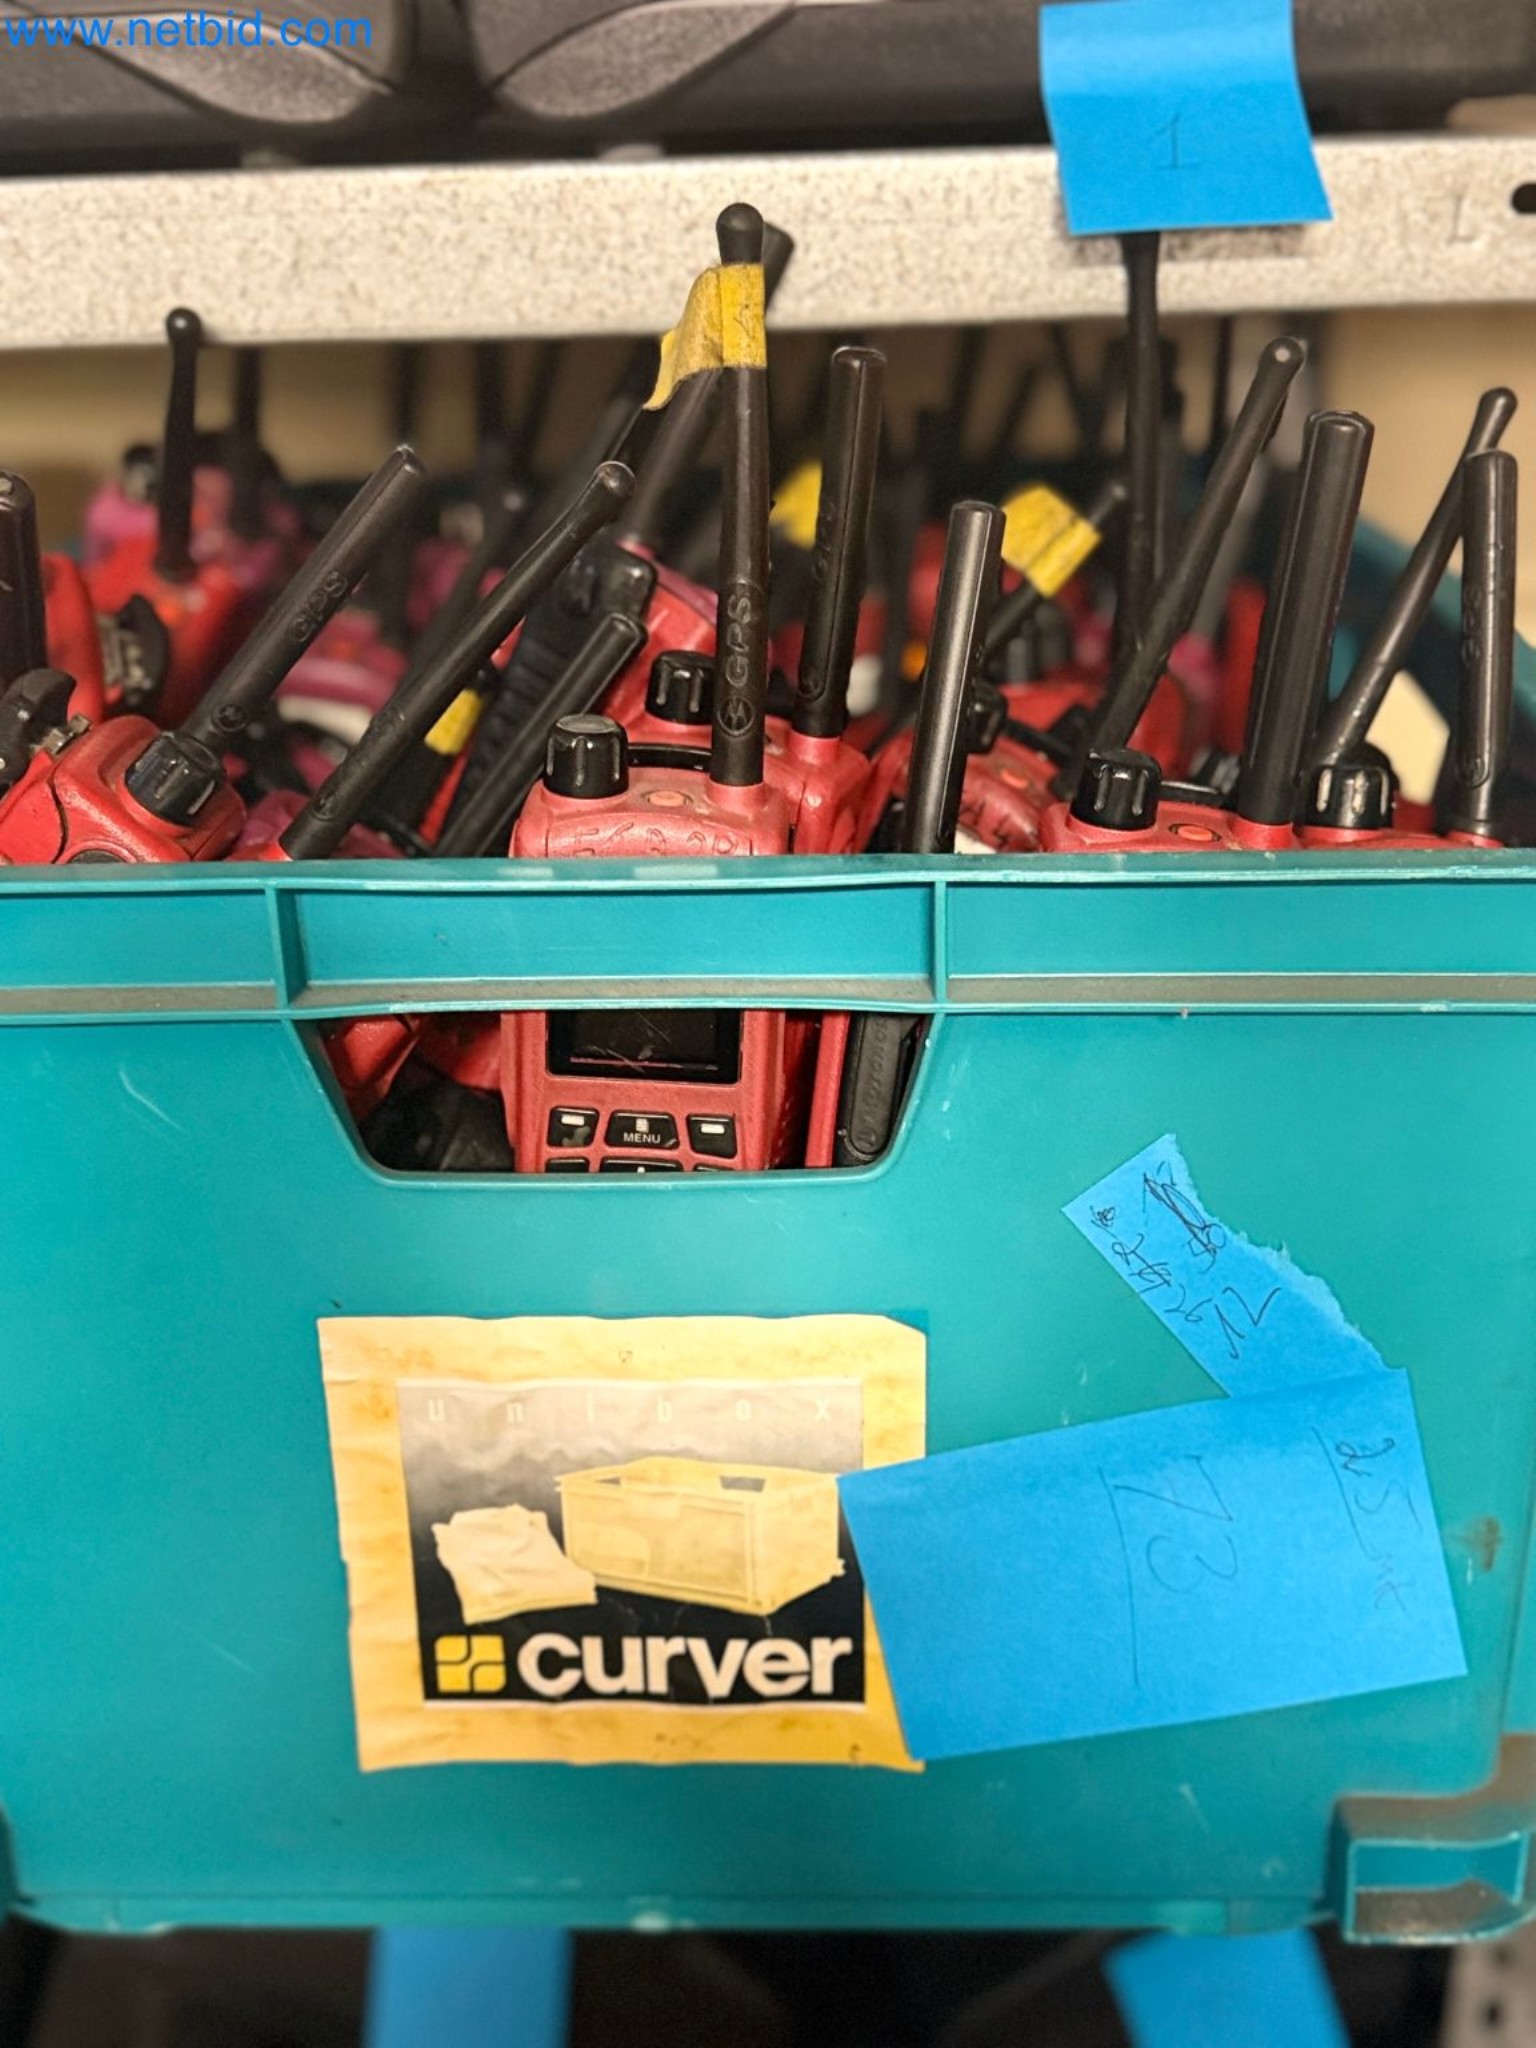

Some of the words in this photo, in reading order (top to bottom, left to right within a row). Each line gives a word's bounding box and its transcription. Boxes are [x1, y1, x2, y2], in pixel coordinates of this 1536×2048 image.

[1146, 112, 1199, 171] 1
[291, 571, 348, 643] GPS
[725, 594, 752, 688] GPS
[622, 1131, 661, 1145] MENU
[516, 1633, 853, 1698] curver
